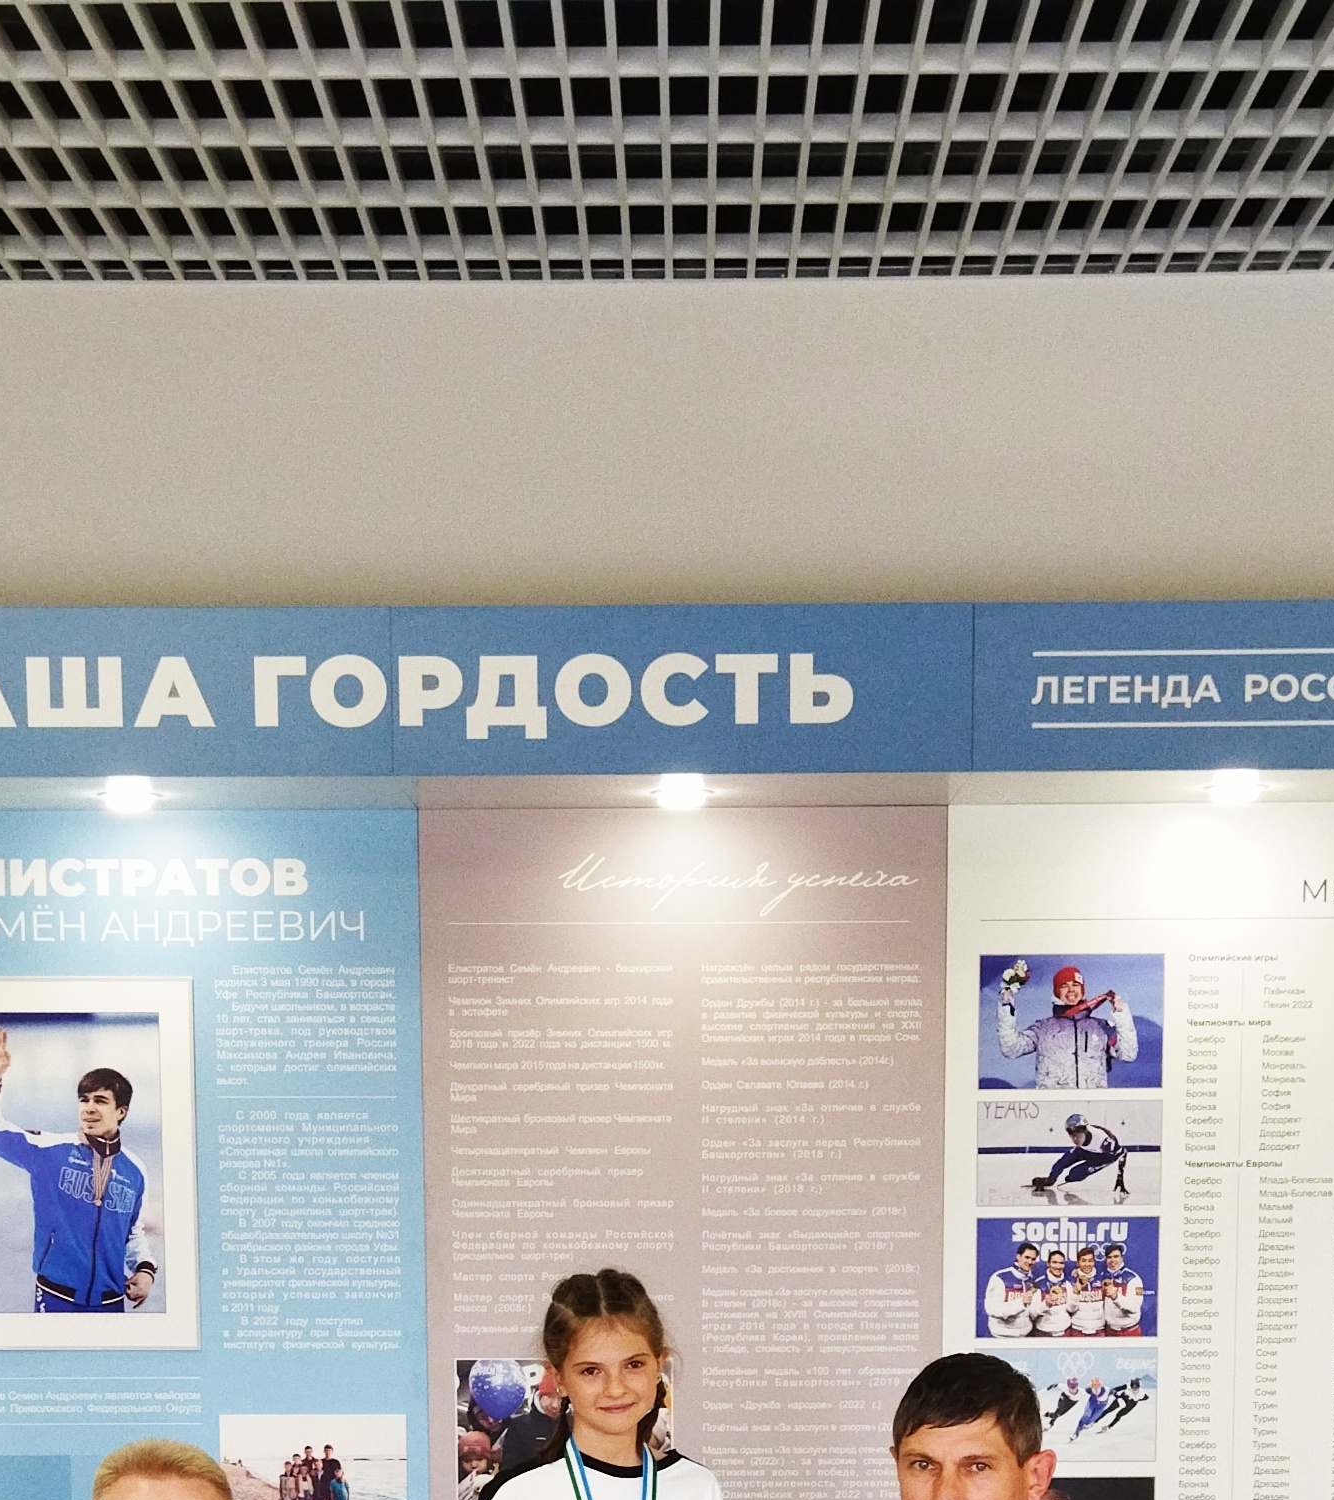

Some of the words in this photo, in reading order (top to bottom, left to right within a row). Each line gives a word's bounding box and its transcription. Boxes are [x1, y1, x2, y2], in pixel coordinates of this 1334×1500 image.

[254, 653, 853, 739] ГОРДОСТЬ
[1032, 675, 1221, 708] ЛЕГЕНДА
[558, 853, 780, 909] История
[760, 869, 919, 916] успеха
[100, 910, 365, 947] АНДРЕЕВИЧ
[232, 965, 293, 977] Елистратов
[214, 980, 258, 989] родился
[245, 990, 309, 1001] Республика
[216, 1038, 296, 1049] Заслуженного
[216, 1050, 278, 1059] Максимова
[301, 1123, 399, 1134] Муниципального
[218, 1135, 290, 1146] бюджетного
[1012, 1217, 1128, 1242] sochi.ru
